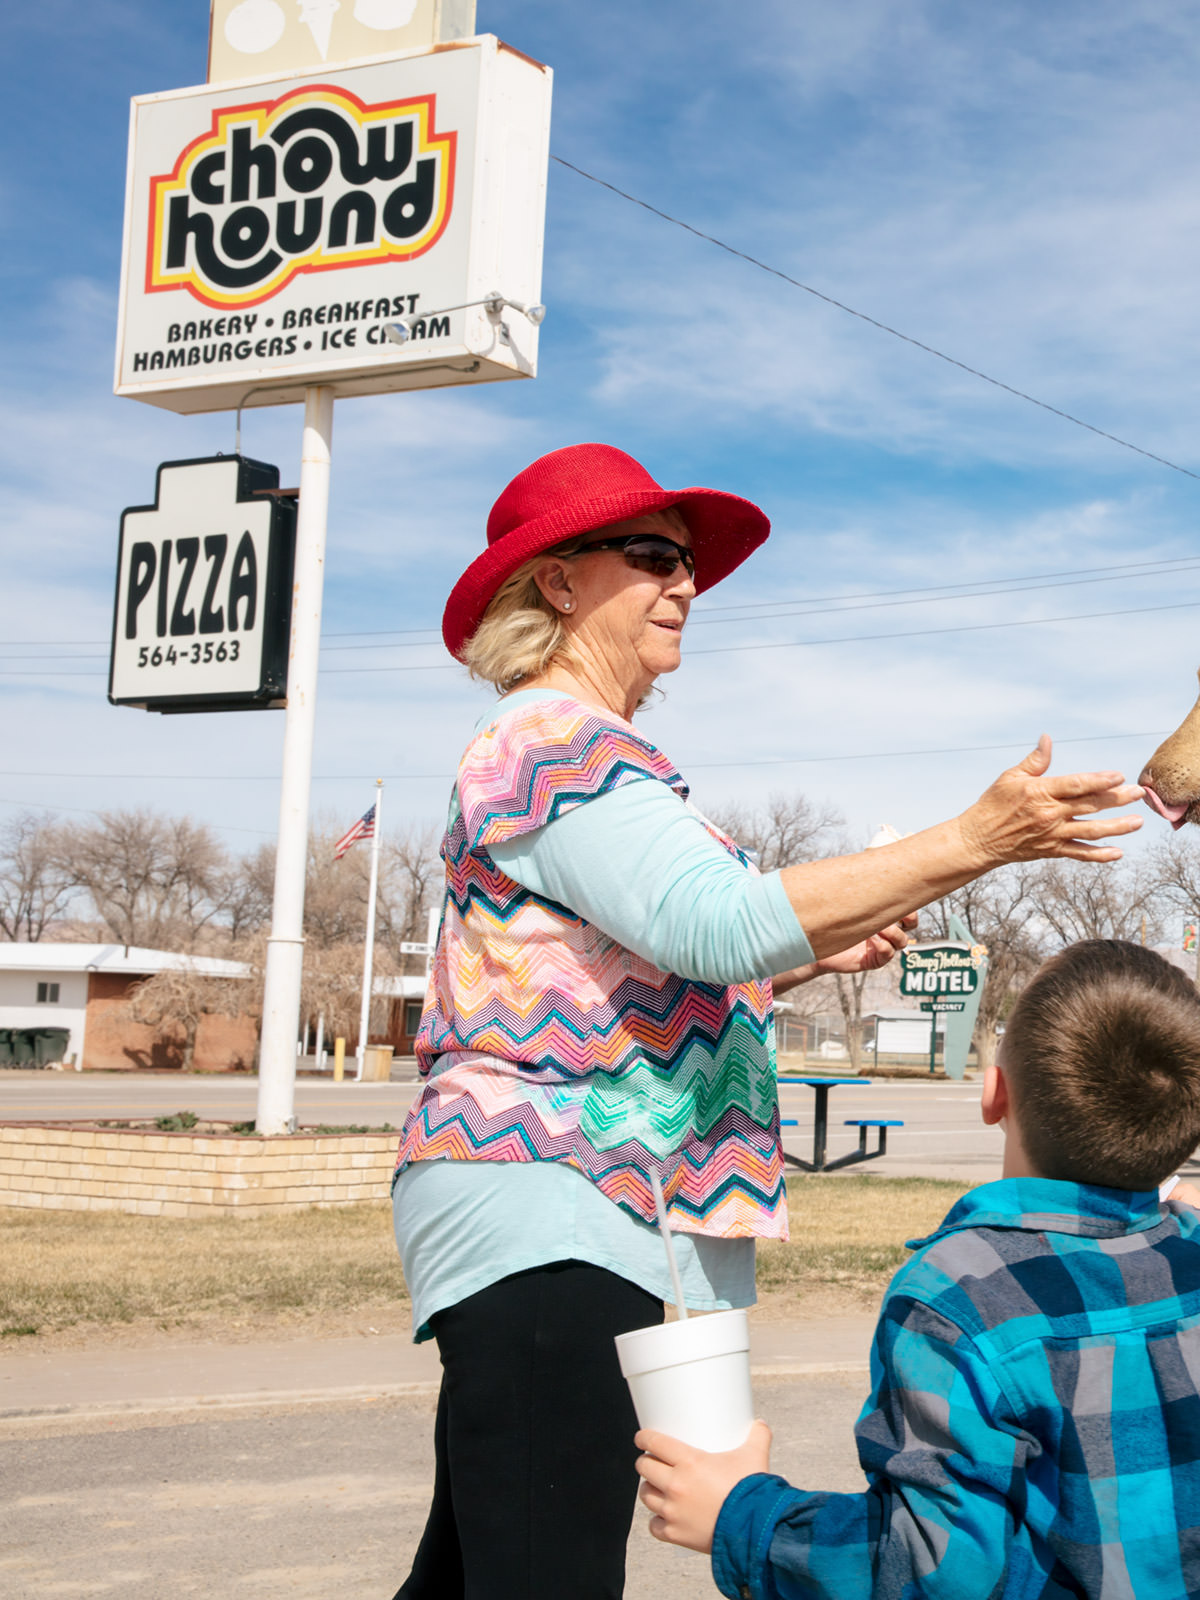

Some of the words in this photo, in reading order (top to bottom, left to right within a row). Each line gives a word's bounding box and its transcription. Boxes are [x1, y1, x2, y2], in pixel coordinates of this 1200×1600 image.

[191, 107, 414, 205] chow
[166, 157, 436, 289] hound
[132, 335, 298, 372] HAMBURGERS
[321, 328, 356, 351] ICE
[366, 315, 450, 345] CAM
[167, 313, 258, 343] BAKERY
[282, 293, 420, 330] BREAKFAST
[125, 529, 258, 640] PIZZA
[137, 640, 240, 668] 564-3563
[905, 971, 974, 992] MOTEL
